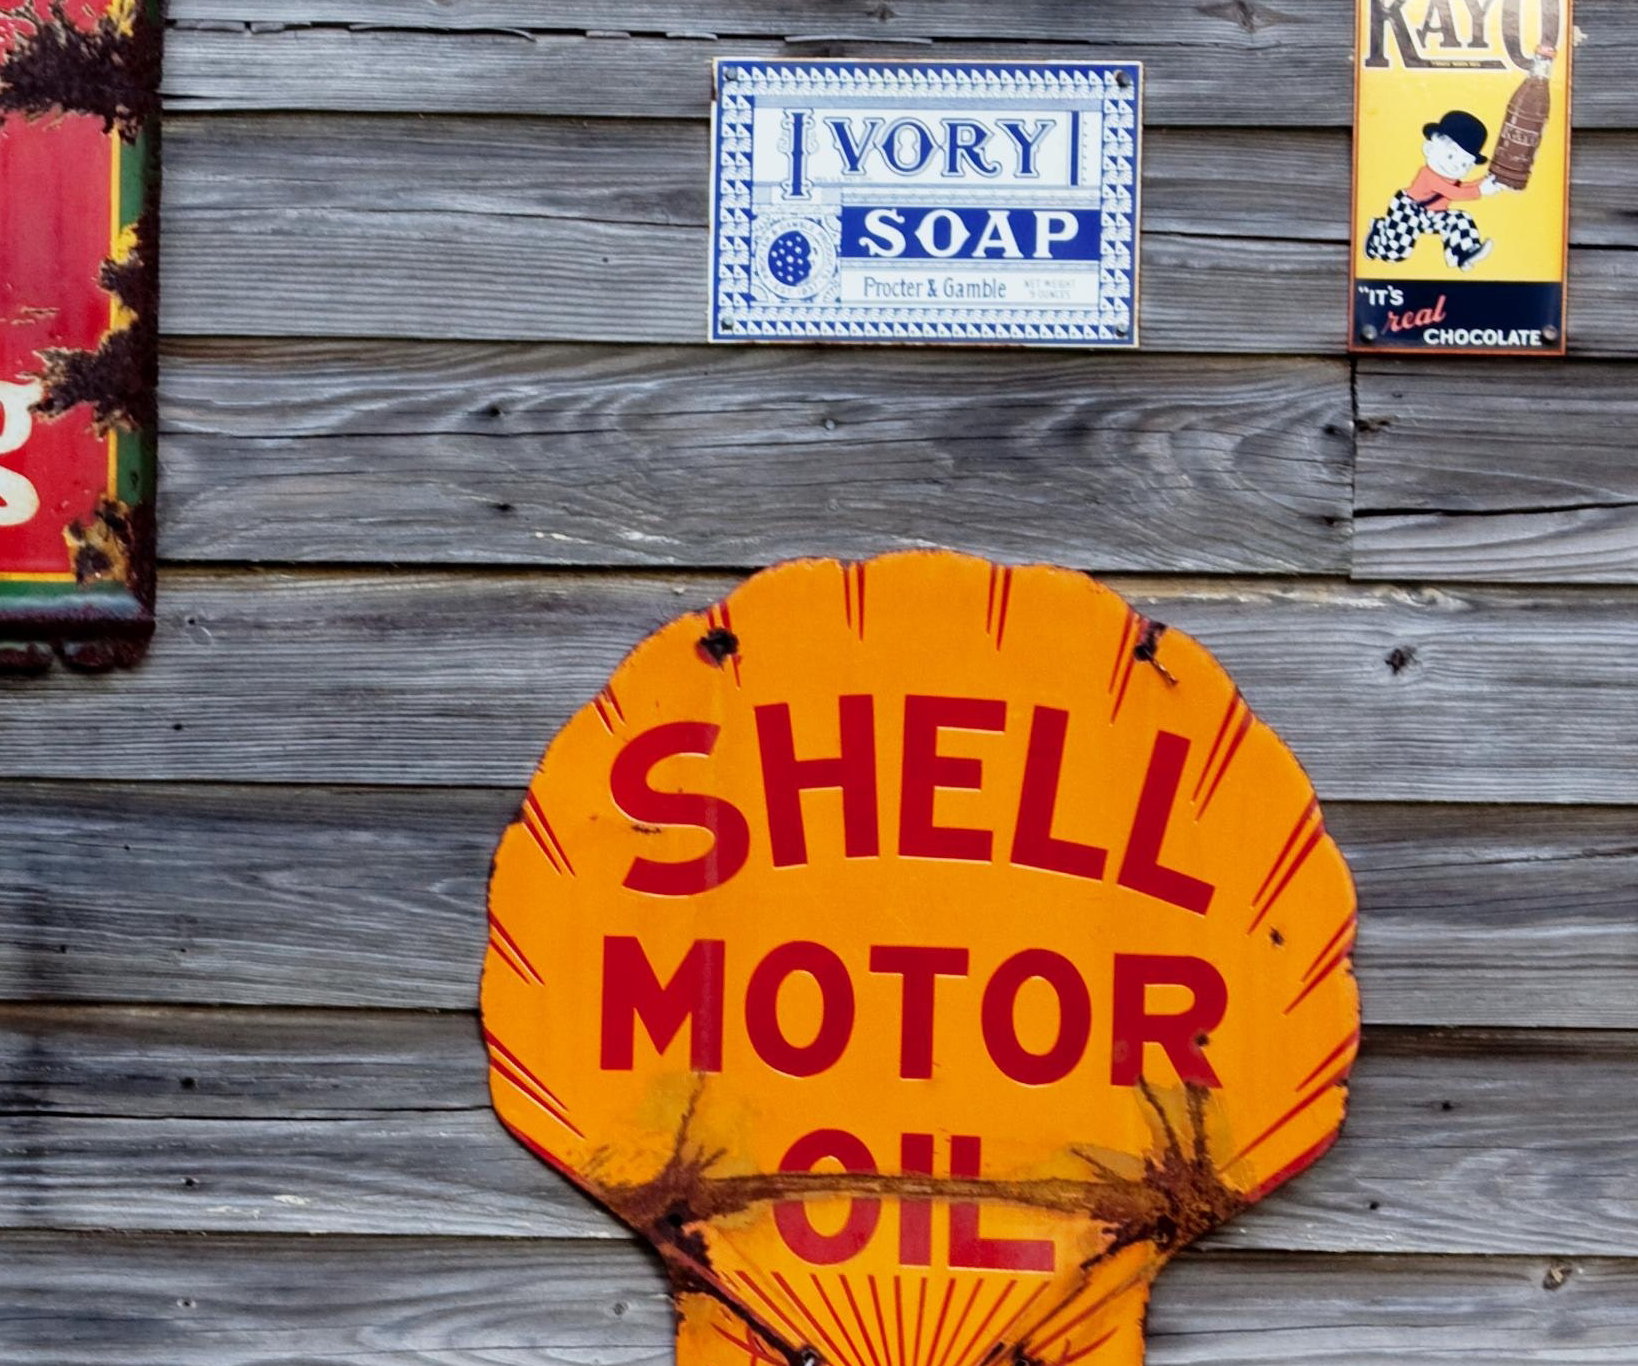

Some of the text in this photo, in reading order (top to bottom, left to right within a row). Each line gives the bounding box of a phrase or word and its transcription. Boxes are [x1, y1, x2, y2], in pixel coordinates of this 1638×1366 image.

[778, 106, 1057, 202] IVORY
[858, 208, 1080, 260] SOAP
[862, 276, 1008, 300] Procter & Gamble
[1380, 294, 1448, 336] real
[1422, 327, 1543, 348] CHOCOLATE
[608, 691, 1218, 918] SHELL
[599, 933, 1229, 1090] MOTOR
[772, 1126, 1057, 1275] OIL
